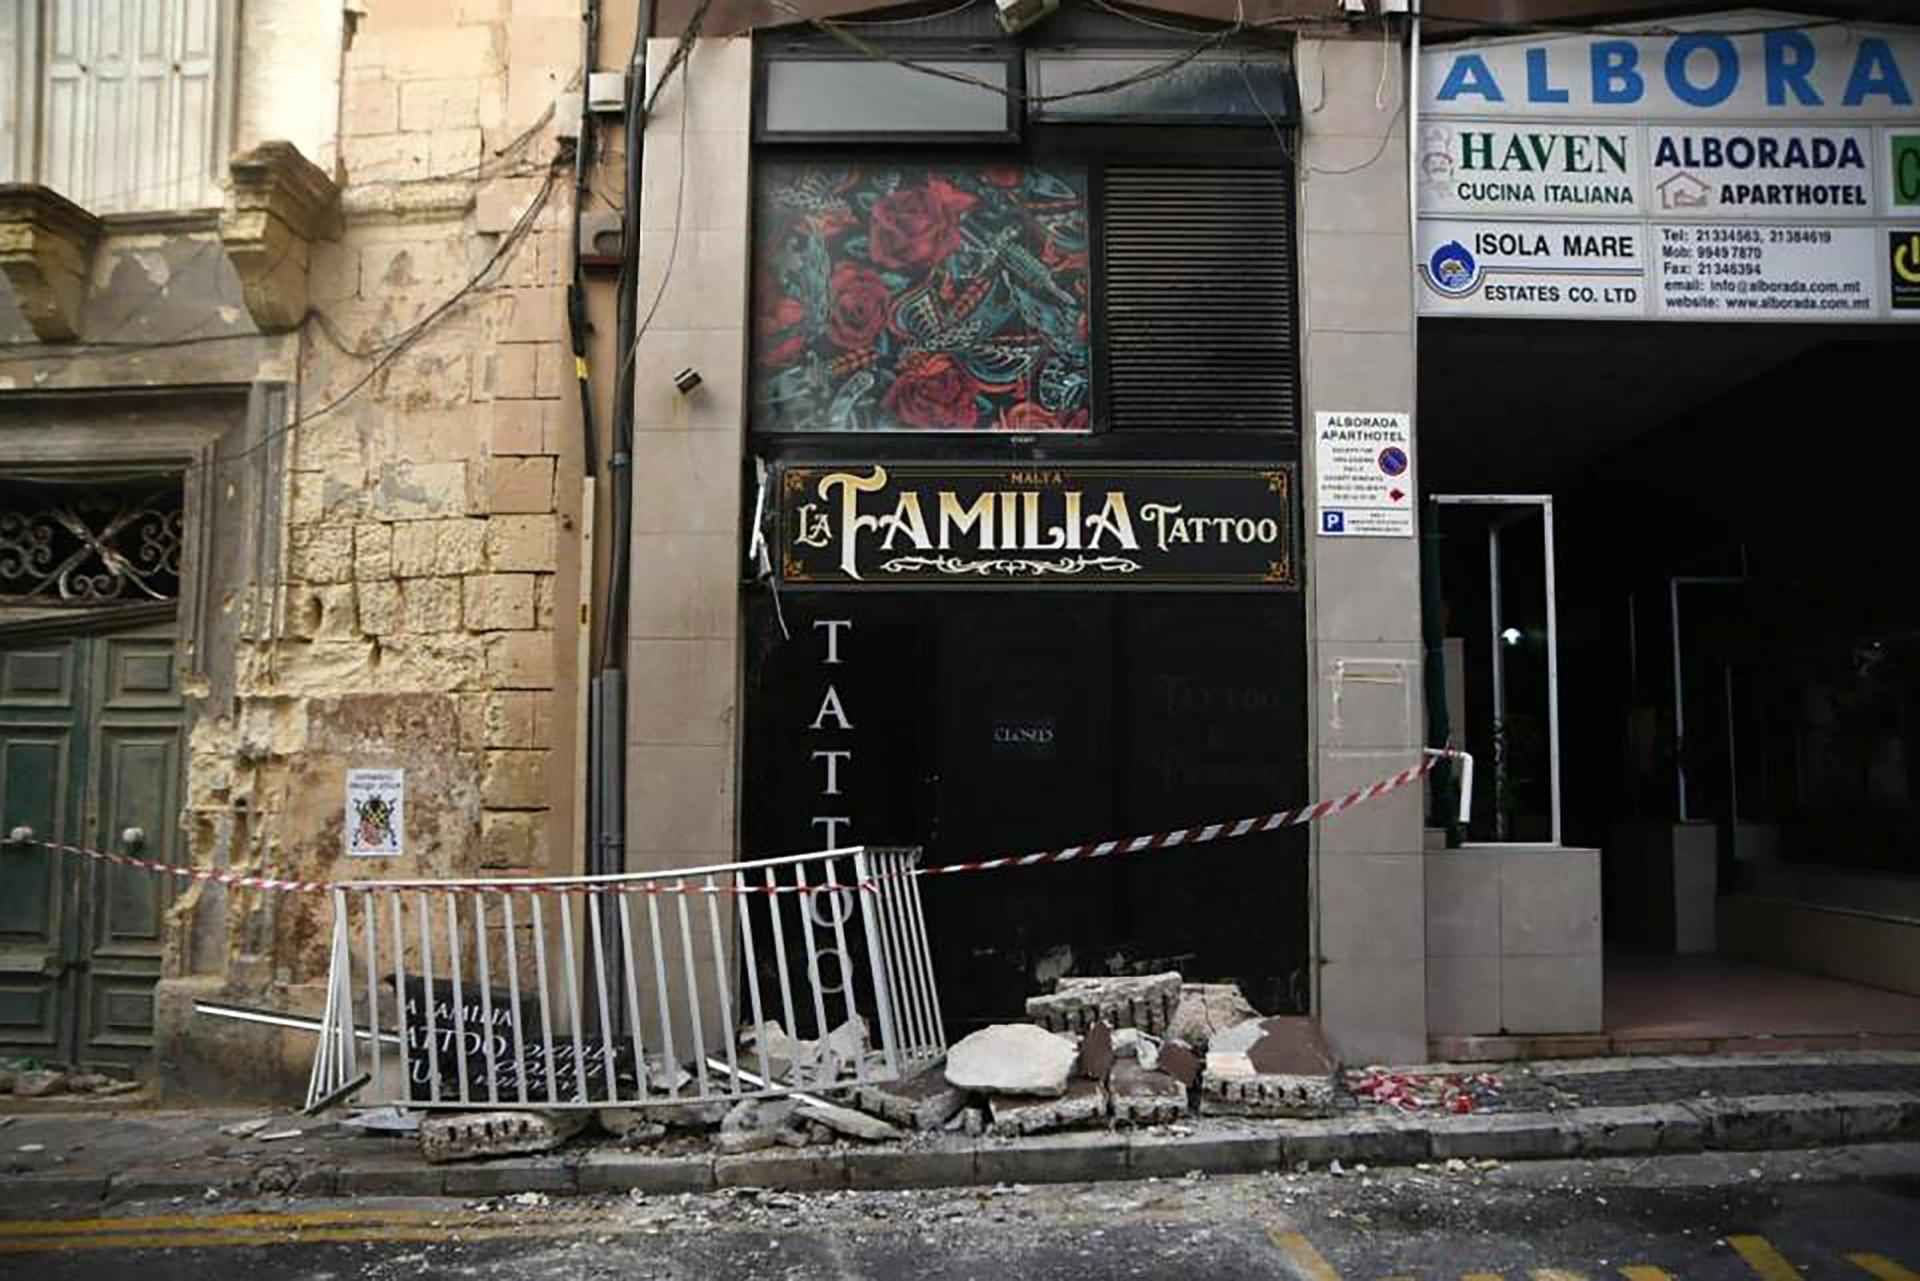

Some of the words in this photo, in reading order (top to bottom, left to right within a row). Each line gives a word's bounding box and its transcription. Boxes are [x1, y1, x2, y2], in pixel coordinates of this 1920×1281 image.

[1436, 29, 1912, 108] ALBORA
[1458, 131, 1628, 174] HAVEN
[1654, 135, 1865, 171] ALBORADA
[1458, 182, 1535, 202] CUCINA
[1544, 184, 1633, 205] ITALIANA
[1720, 184, 1867, 206] APARTHOTEL
[1663, 228, 1689, 243] Tel:
[1475, 232, 1550, 257] ISOLA
[1563, 235, 1634, 258] MARE
[1662, 245, 1693, 259] Mob:
[1663, 262, 1692, 275] Fax:
[1485, 285, 1560, 302] ESTATES
[1569, 287, 1598, 303] CO.
[1604, 287, 1637, 303] LTD
[1664, 280, 1705, 292] email:
[1665, 296, 1719, 309] website:
[1726, 297, 1870, 310] www.alborada.com.mt
[1327, 416, 1398, 428] ALBORADA
[1321, 430, 1405, 442] APARTHOTEL
[818, 465, 1140, 581] FAMILIA
[1140, 502, 1279, 552] TATTOO
[1327, 513, 1340, 529] P
